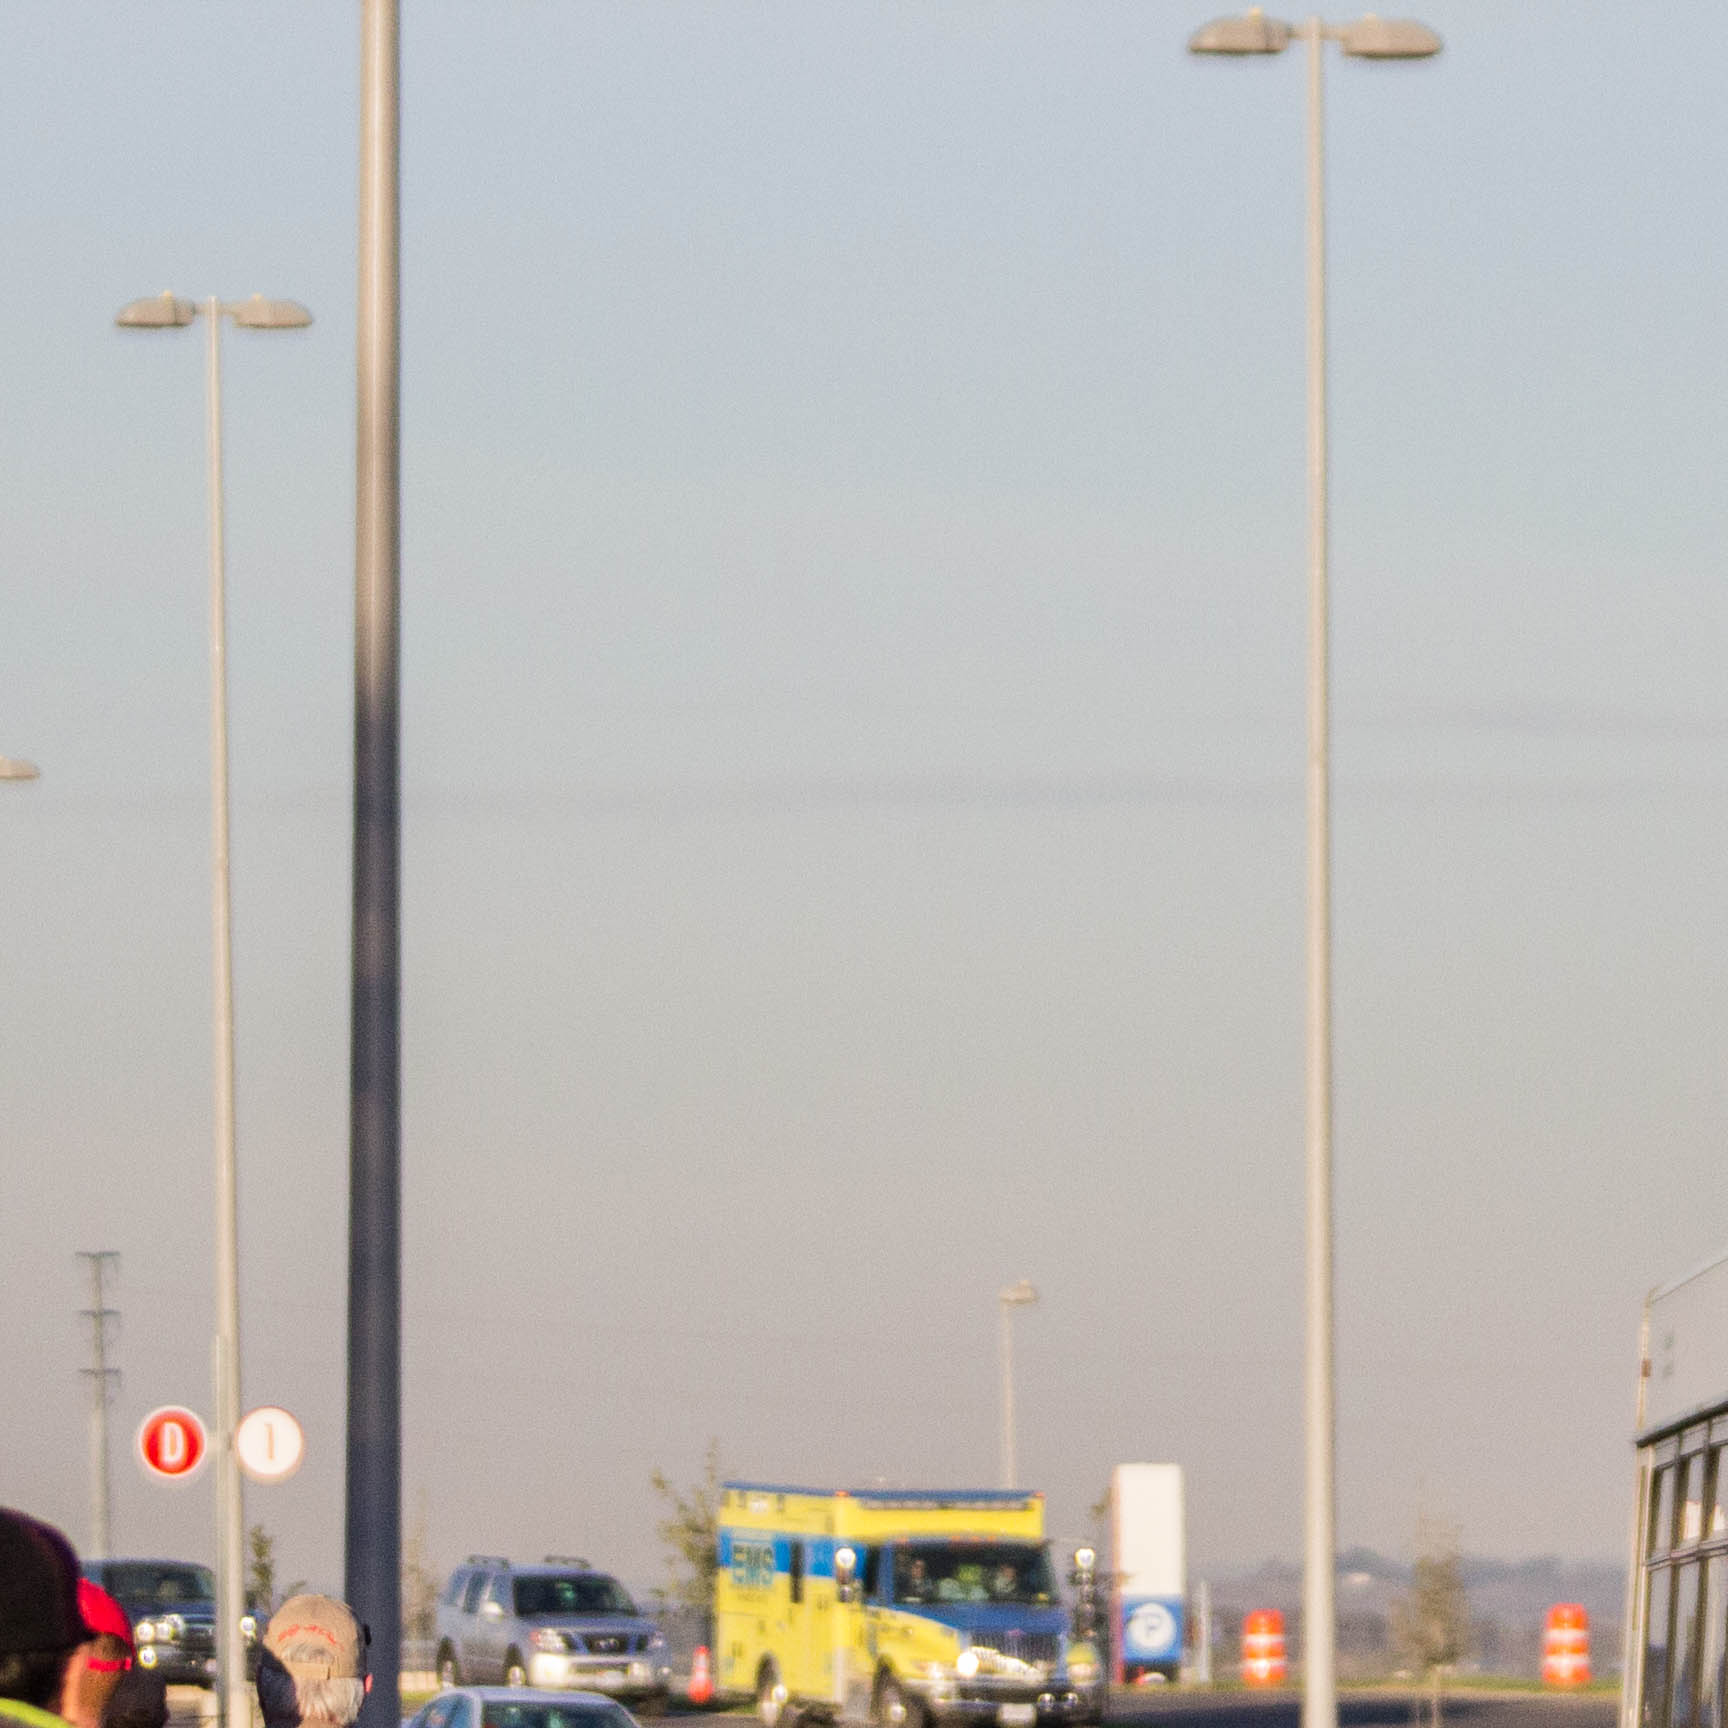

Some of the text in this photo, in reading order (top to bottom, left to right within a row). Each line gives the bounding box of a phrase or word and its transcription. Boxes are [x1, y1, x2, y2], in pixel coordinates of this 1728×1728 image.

[162, 1422, 275, 1464] D 1
[732, 1543, 774, 1586] EMS
